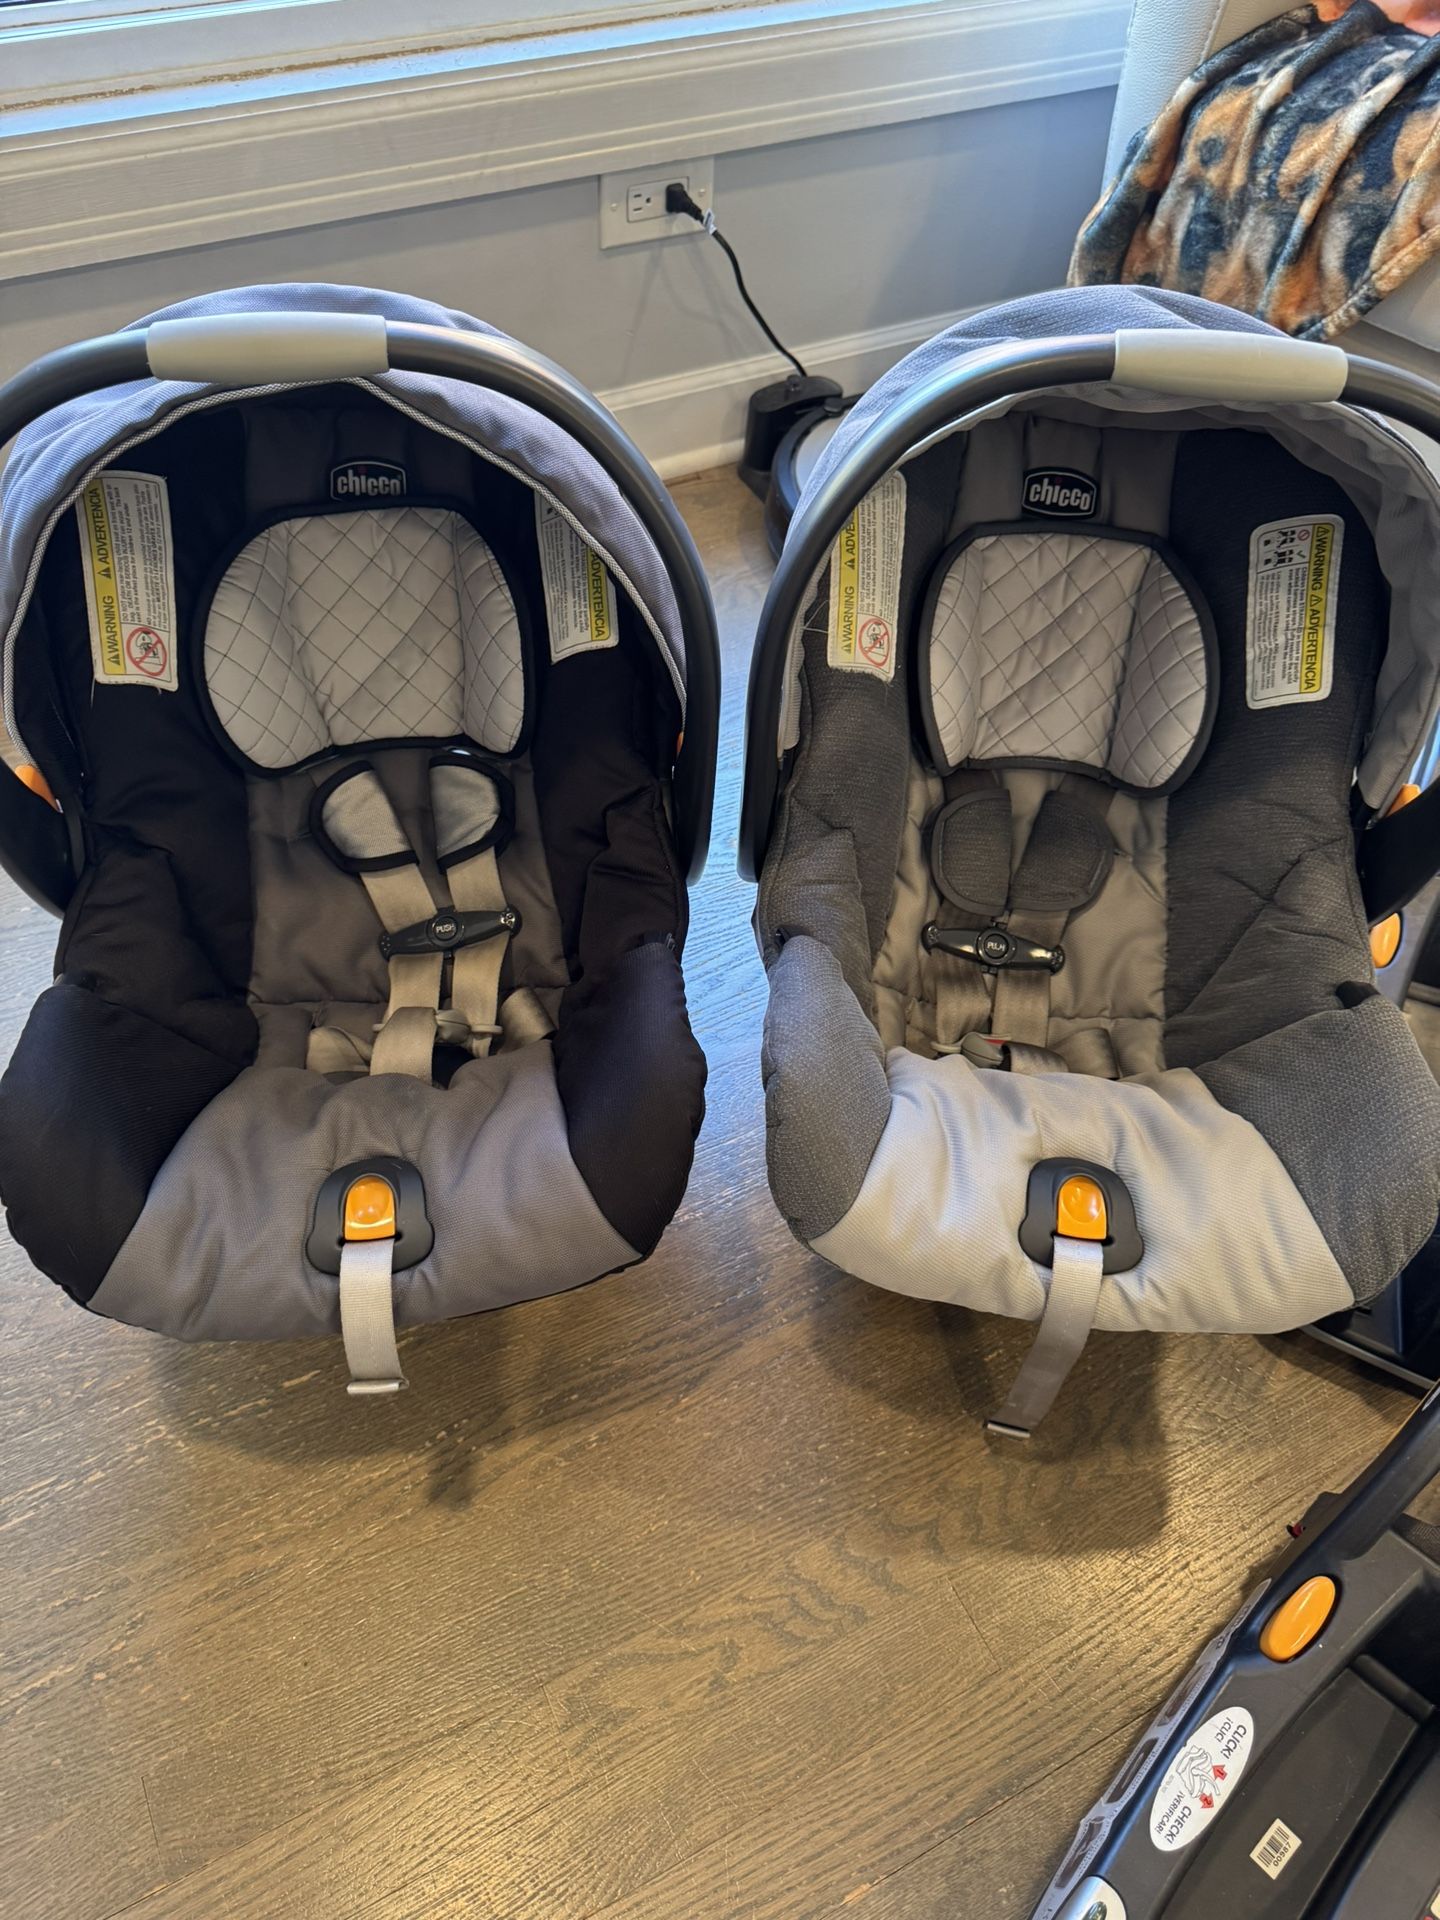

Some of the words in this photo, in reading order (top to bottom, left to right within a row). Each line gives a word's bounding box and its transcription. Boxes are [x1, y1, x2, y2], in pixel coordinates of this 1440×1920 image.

[337, 469, 401, 496] chicco
[1029, 478, 1091, 510] chicco
[93, 487, 110, 565] ADVERTENCIA
[1311, 537, 1326, 591] WARNING
[591, 553, 606, 638] ADVERTENCIA
[843, 586, 854, 642] WARNING
[102, 595, 120, 653] WARNING
[1304, 608, 1320, 690] ADVERTENCIA
[1215, 1717, 1233, 1742] ¡CLIC!
[1220, 1724, 1247, 1759] CLICK!
[1154, 1791, 1185, 1834] ¡VERIFICAR!
[1164, 1806, 1192, 1844] CHECK!
[1273, 1842, 1292, 1867] 00987
